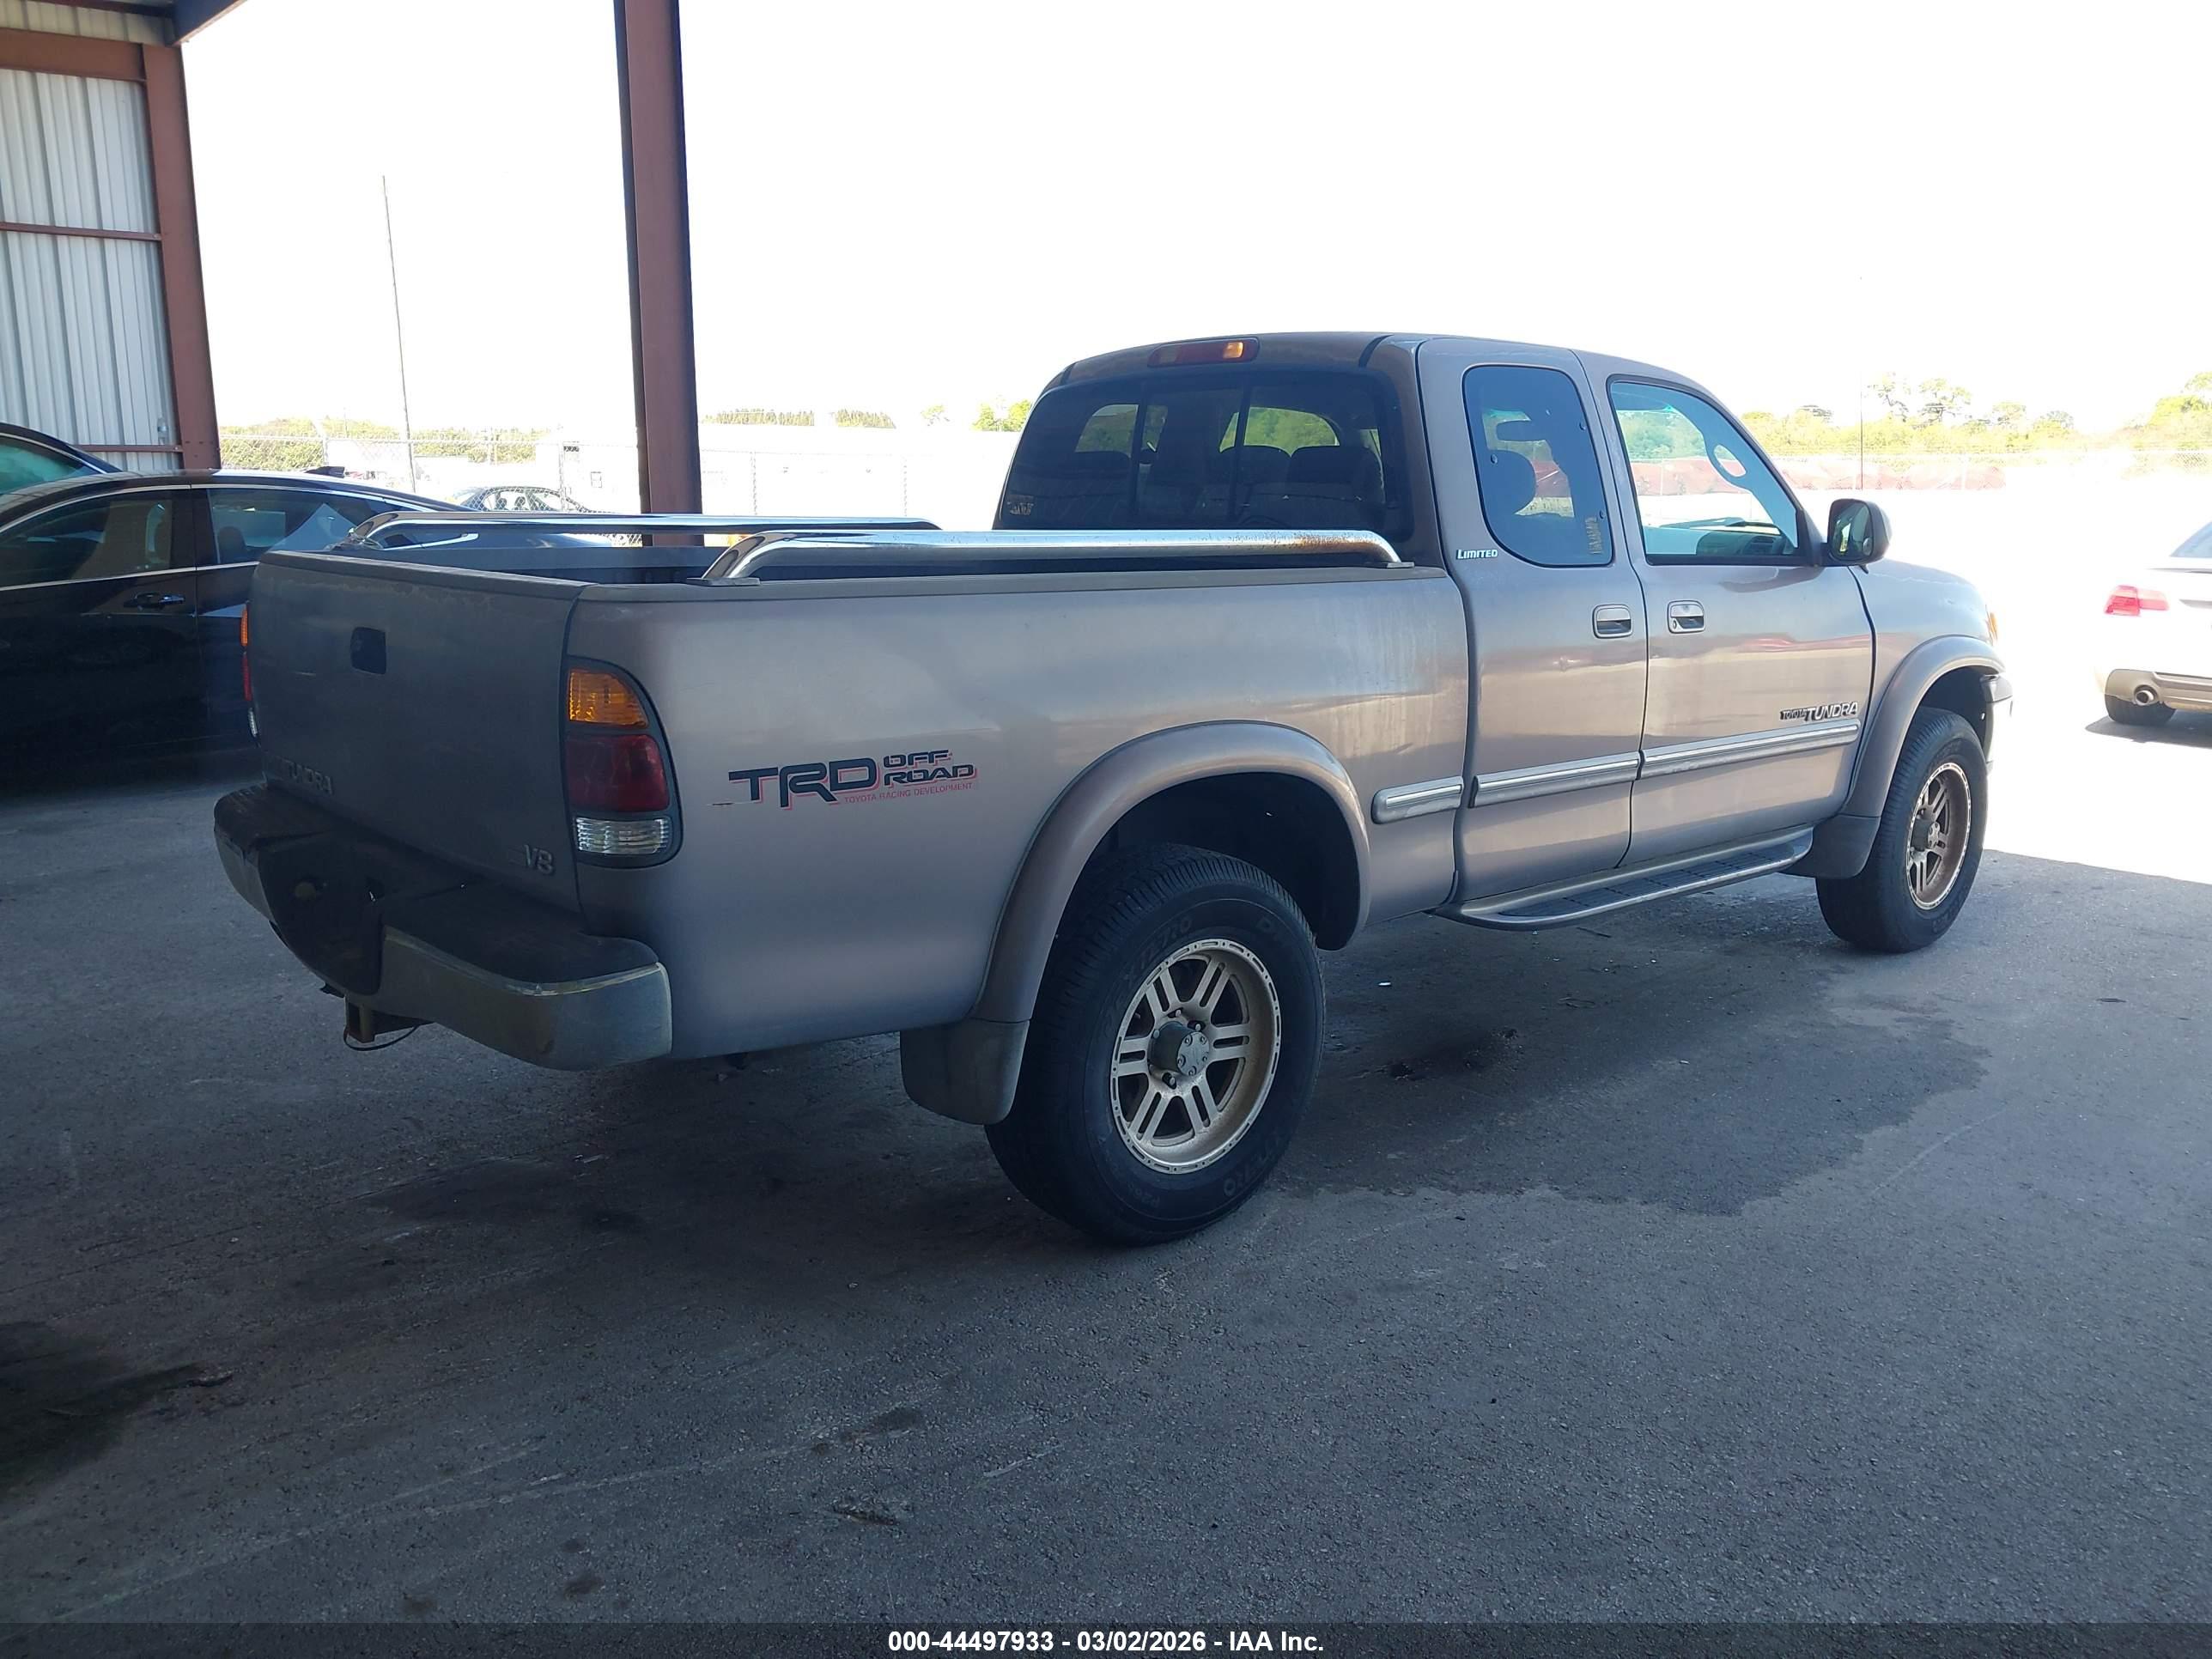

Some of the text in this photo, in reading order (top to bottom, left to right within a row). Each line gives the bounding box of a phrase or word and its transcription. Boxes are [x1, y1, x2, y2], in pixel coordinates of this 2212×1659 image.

[1803, 702, 1859, 721] TUNDRA
[883, 750, 951, 769] OFF
[728, 757, 879, 810] TRD
[883, 763, 977, 787] ROAD
[844, 782, 973, 804] TOYOTA RACING DEVELOPMENT
[523, 844, 554, 874] V8
